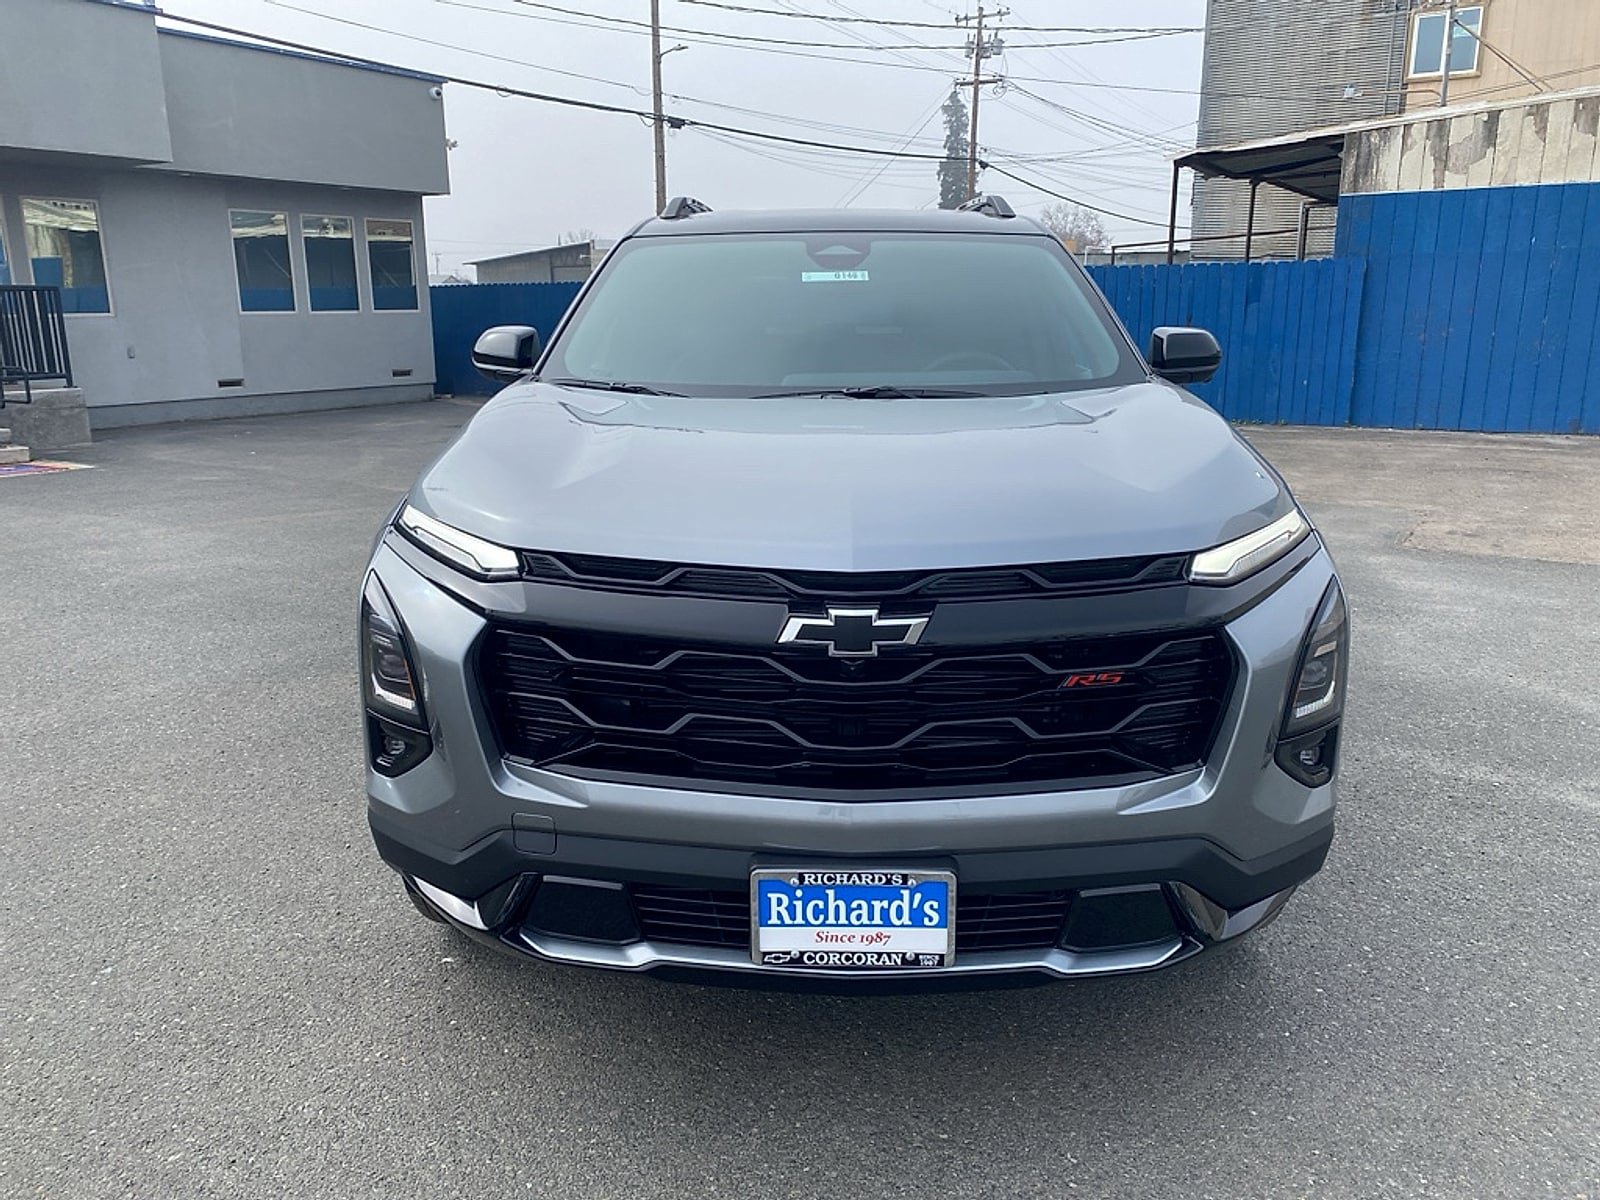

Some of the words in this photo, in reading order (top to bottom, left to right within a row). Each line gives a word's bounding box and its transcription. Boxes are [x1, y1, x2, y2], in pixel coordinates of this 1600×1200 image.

[1062, 672, 1122, 687] RS
[803, 873, 903, 886] RICHARD'S
[767, 889, 941, 927] Richard's
[815, 931, 856, 944] Since
[859, 932, 891, 945] 1987
[802, 952, 903, 966] CORCORAN
